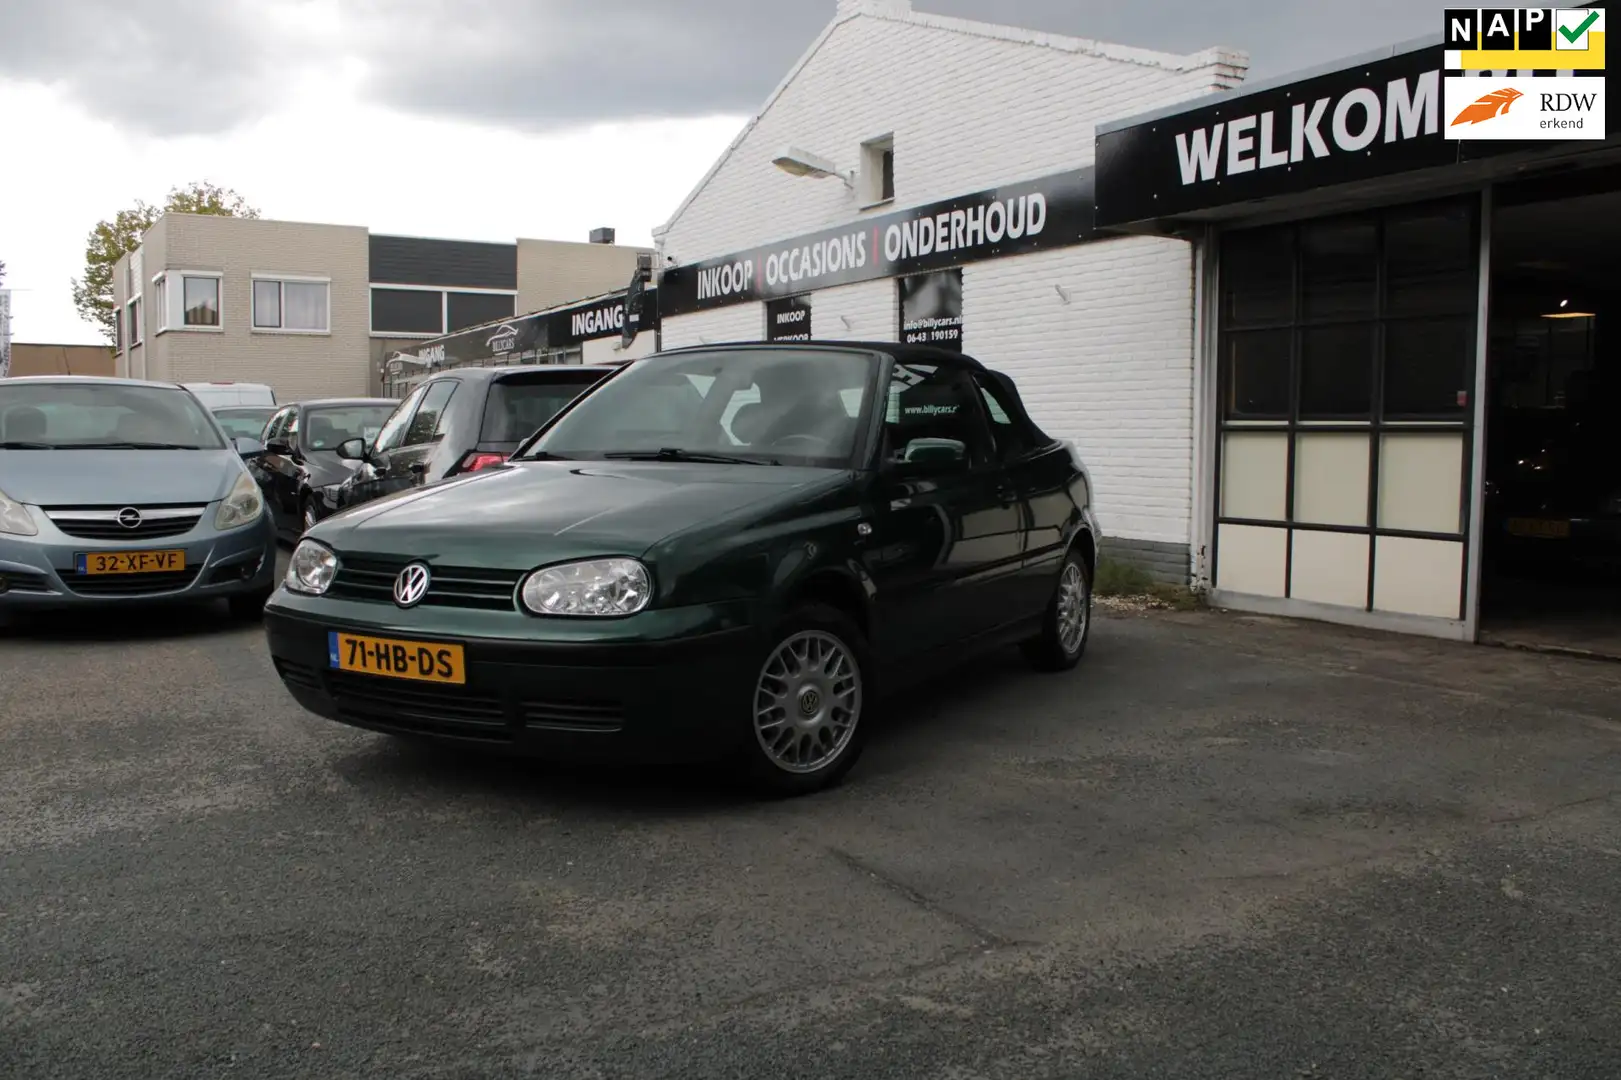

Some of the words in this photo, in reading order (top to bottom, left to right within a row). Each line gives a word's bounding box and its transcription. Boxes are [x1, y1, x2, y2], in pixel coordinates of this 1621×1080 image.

[1175, 69, 1440, 185] WELKOM
[697, 259, 752, 300] INKOOP
[765, 231, 866, 286] OCCASIONS
[884, 192, 1046, 262] ONDERHOUD
[571, 304, 624, 336] INGANG
[776, 310, 806, 324] INKOOP
[903, 315, 962, 331] info@billycars.nl
[930, 329, 959, 341] 190159
[96, 553, 177, 571] 32-XF-VF
[344, 638, 454, 678] 71-HB-DS
